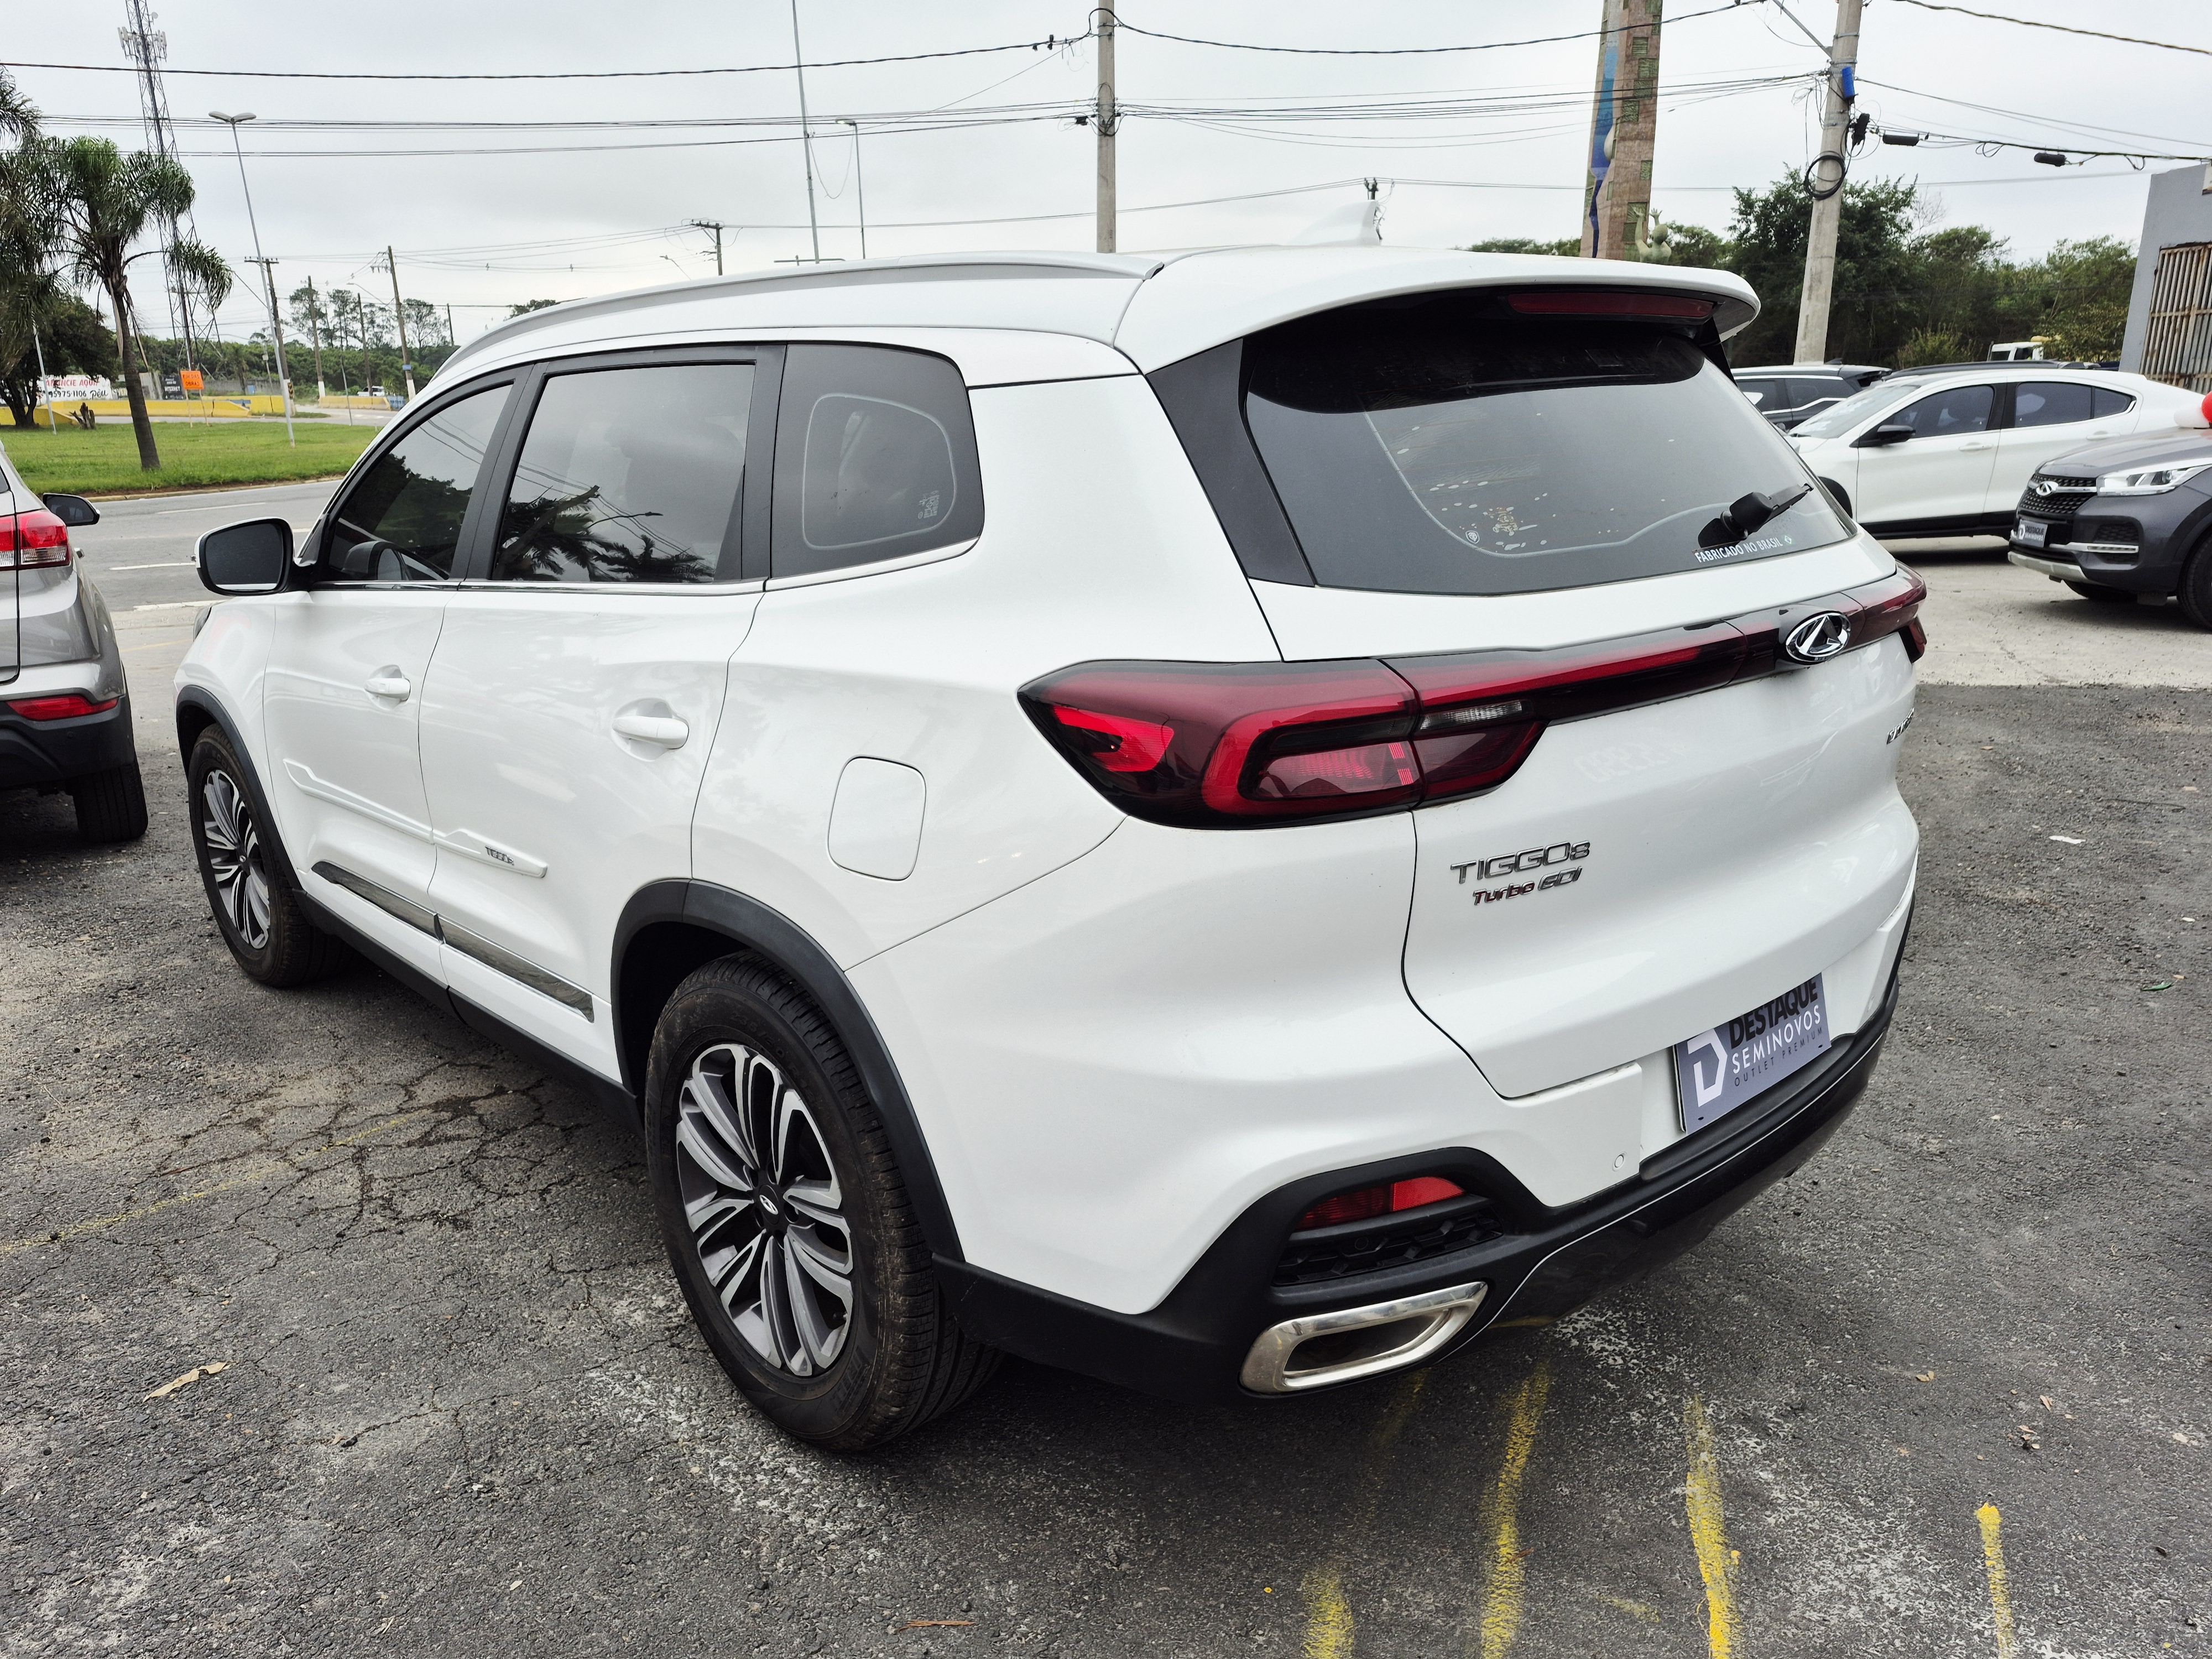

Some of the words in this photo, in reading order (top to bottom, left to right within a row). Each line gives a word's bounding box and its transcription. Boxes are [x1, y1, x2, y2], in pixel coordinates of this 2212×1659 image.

[1694, 545, 1744, 563] FABRICADO
[1744, 542, 1758, 553] NO
[1756, 536, 1783, 552] BRASIL
[1473, 880, 1535, 906] Turbo
[1729, 979, 1818, 1050] DESTAQUE
[1731, 1004, 1821, 1074] SEMINOVOS
[1734, 1057, 1775, 1087] OUTLET
[1782, 1027, 1824, 1059] PREMIUM
